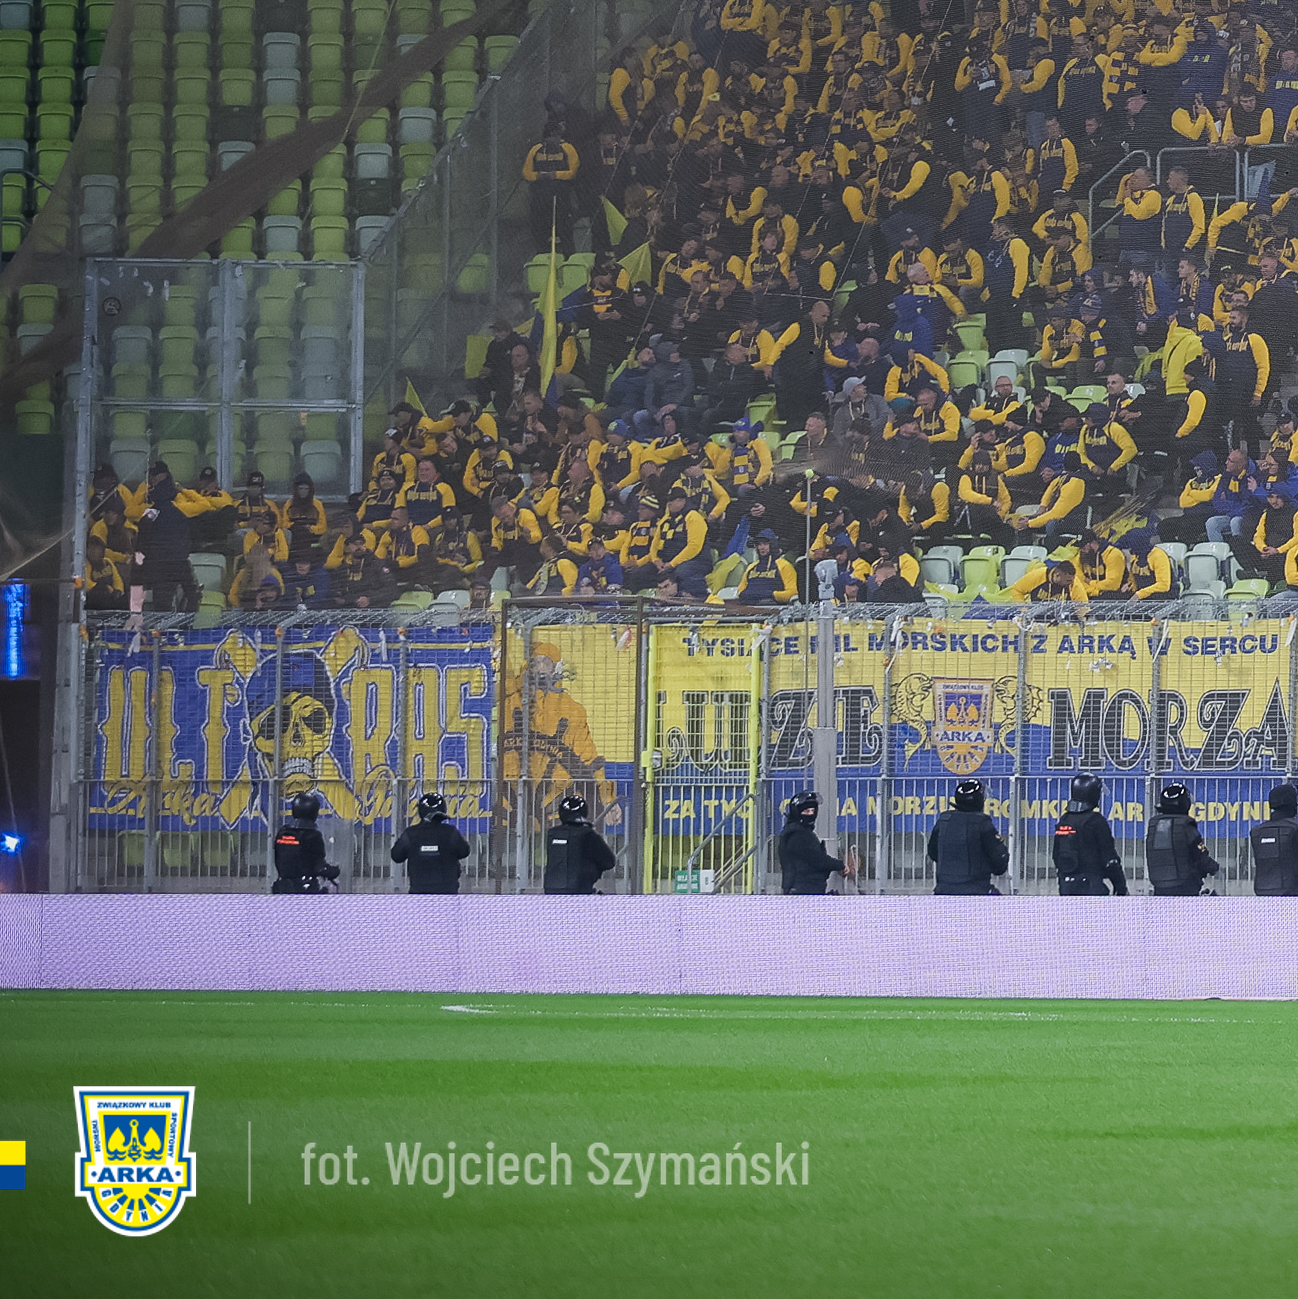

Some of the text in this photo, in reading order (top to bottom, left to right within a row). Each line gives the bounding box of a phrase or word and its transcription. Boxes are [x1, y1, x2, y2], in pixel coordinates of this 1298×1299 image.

[1030, 634, 1048, 653] Z
[1057, 634, 1137, 659] ARKĄ
[1183, 634, 1278, 655] SERCU
[1047, 674, 1294, 772] MORZA
[940, 731, 985, 743] ARKA
[664, 799, 695, 819] ZA
